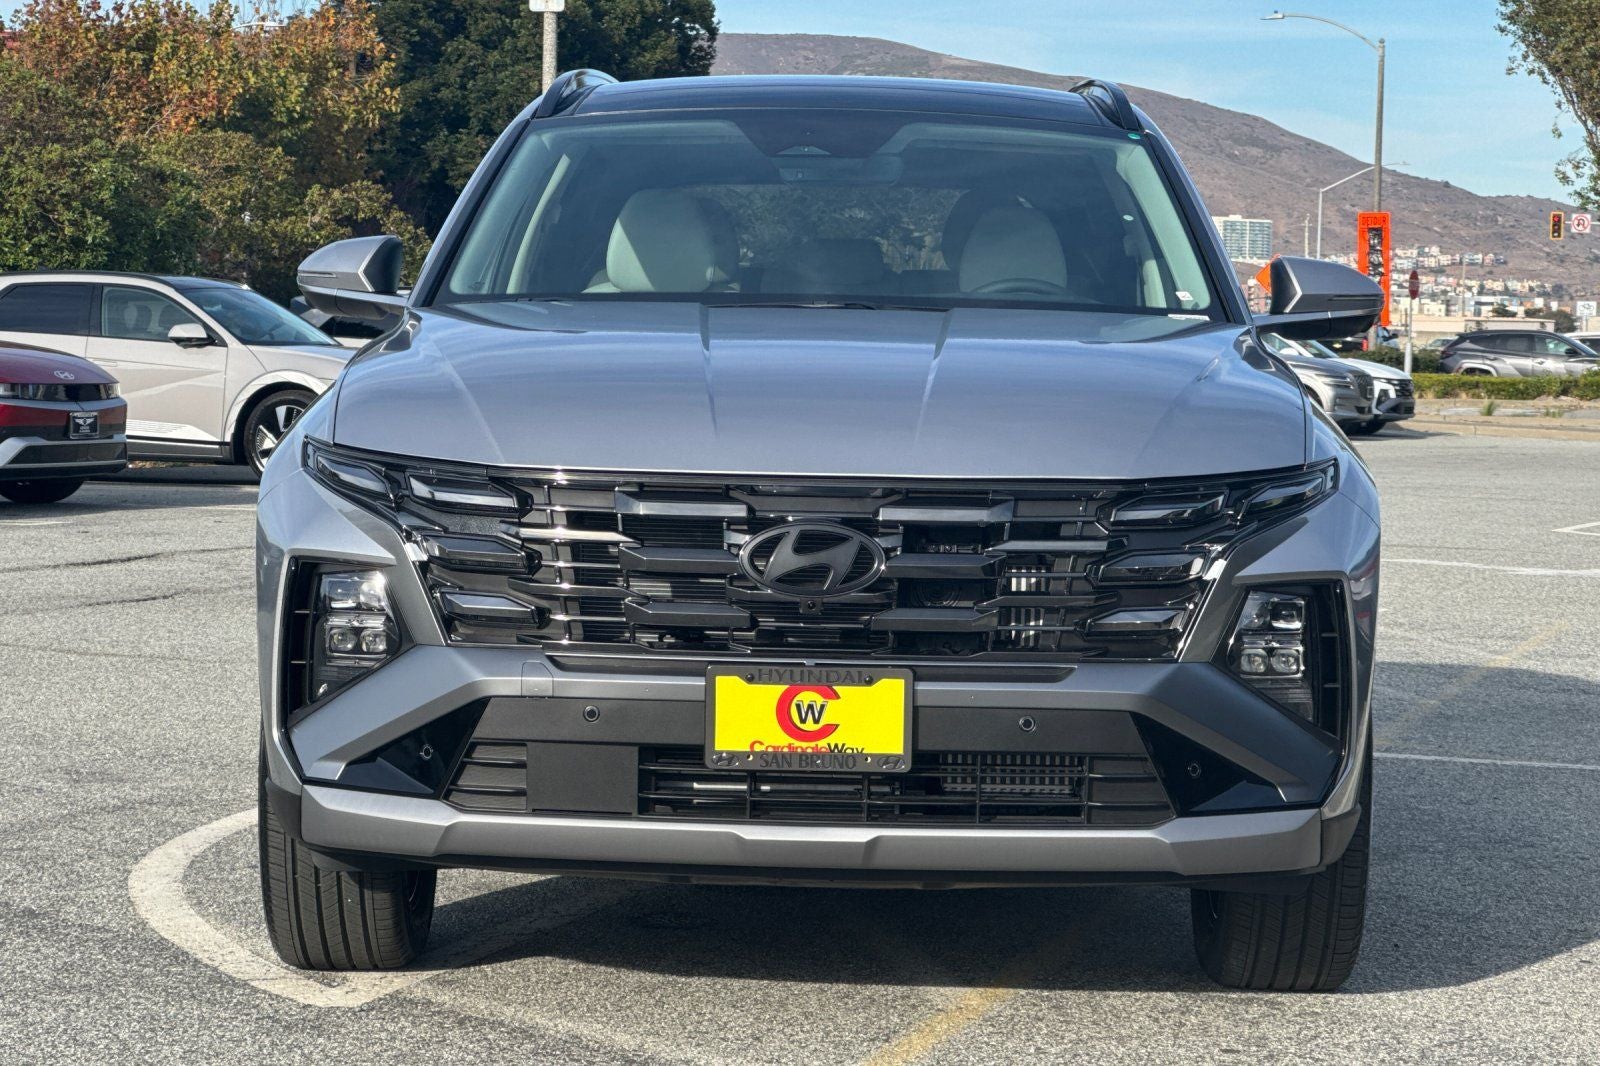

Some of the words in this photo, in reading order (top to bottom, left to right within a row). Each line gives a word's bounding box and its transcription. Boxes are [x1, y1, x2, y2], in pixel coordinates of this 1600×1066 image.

[1361, 216, 1387, 226] DETOUR
[757, 668, 863, 683] HYUNDAI
[759, 753, 792, 769] SAN
[798, 754, 857, 770] BRUNO
